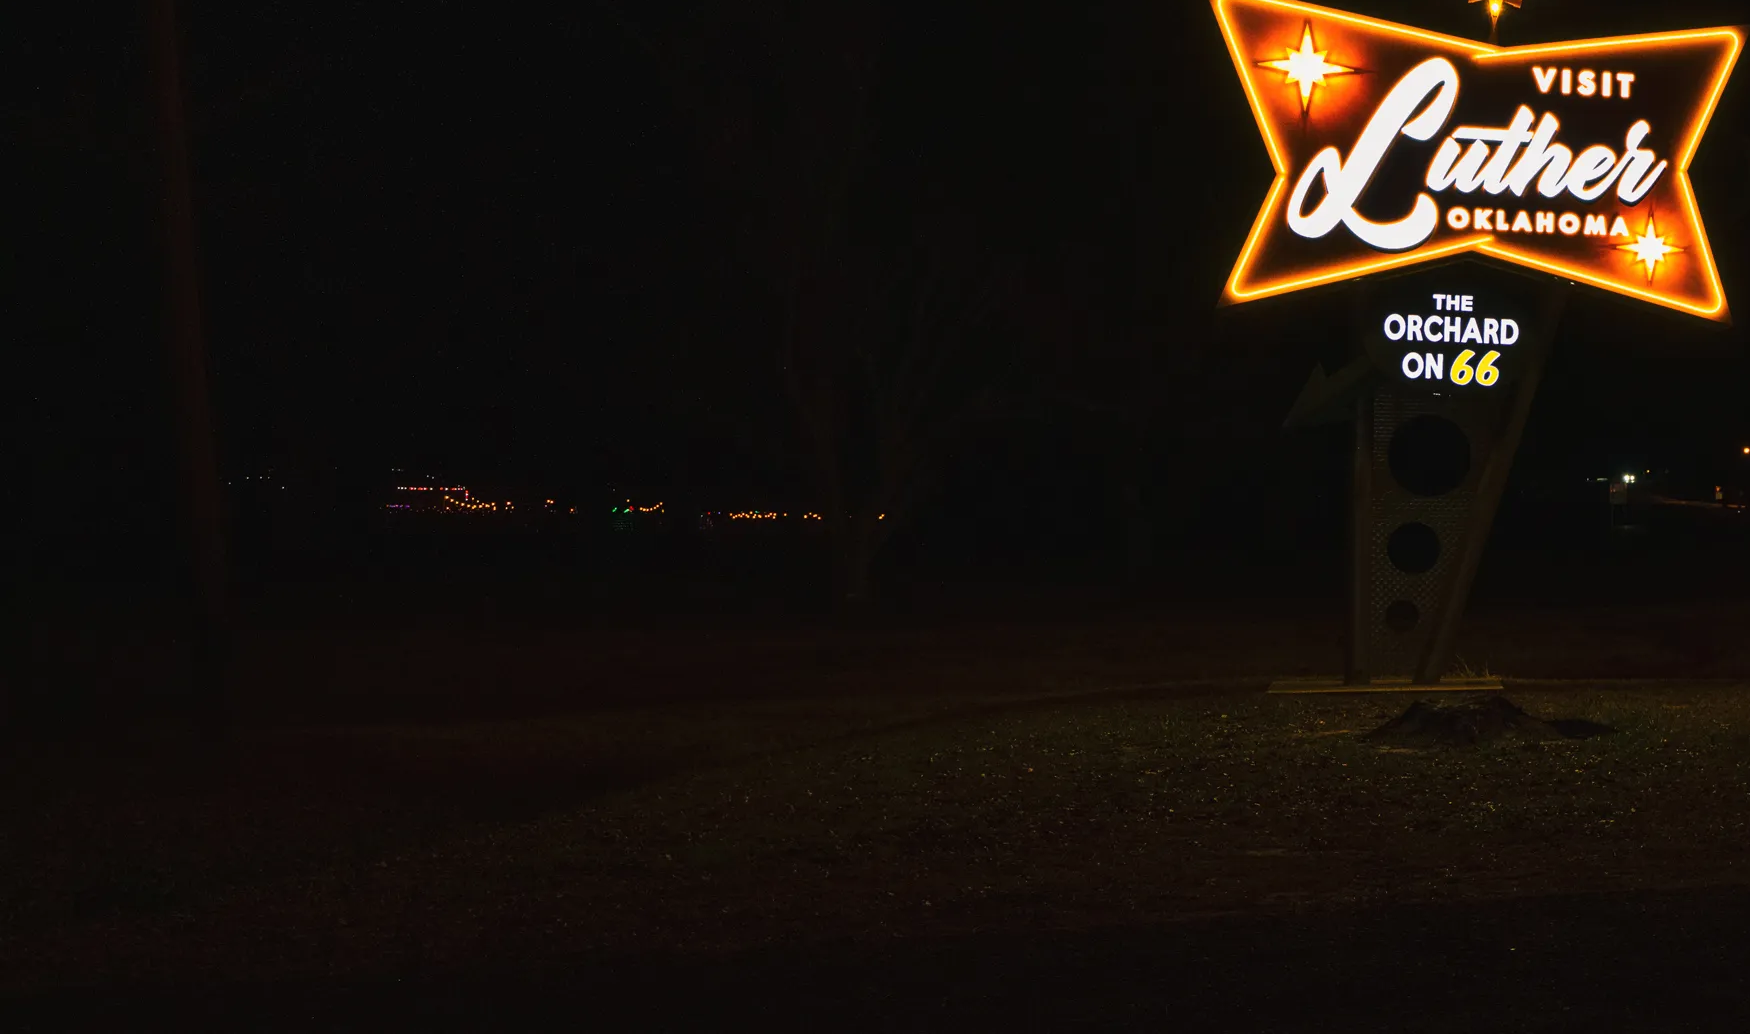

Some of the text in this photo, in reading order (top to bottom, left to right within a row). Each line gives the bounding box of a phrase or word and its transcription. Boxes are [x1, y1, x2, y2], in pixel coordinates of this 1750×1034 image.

[1532, 67, 1635, 98] VISIT
[1287, 57, 1667, 250] Luther
[1447, 208, 1630, 237] OKLAHOMA
[1432, 293, 1474, 312] THE
[1383, 313, 1520, 346] ORCHARD
[1401, 348, 1501, 387] ON 66
